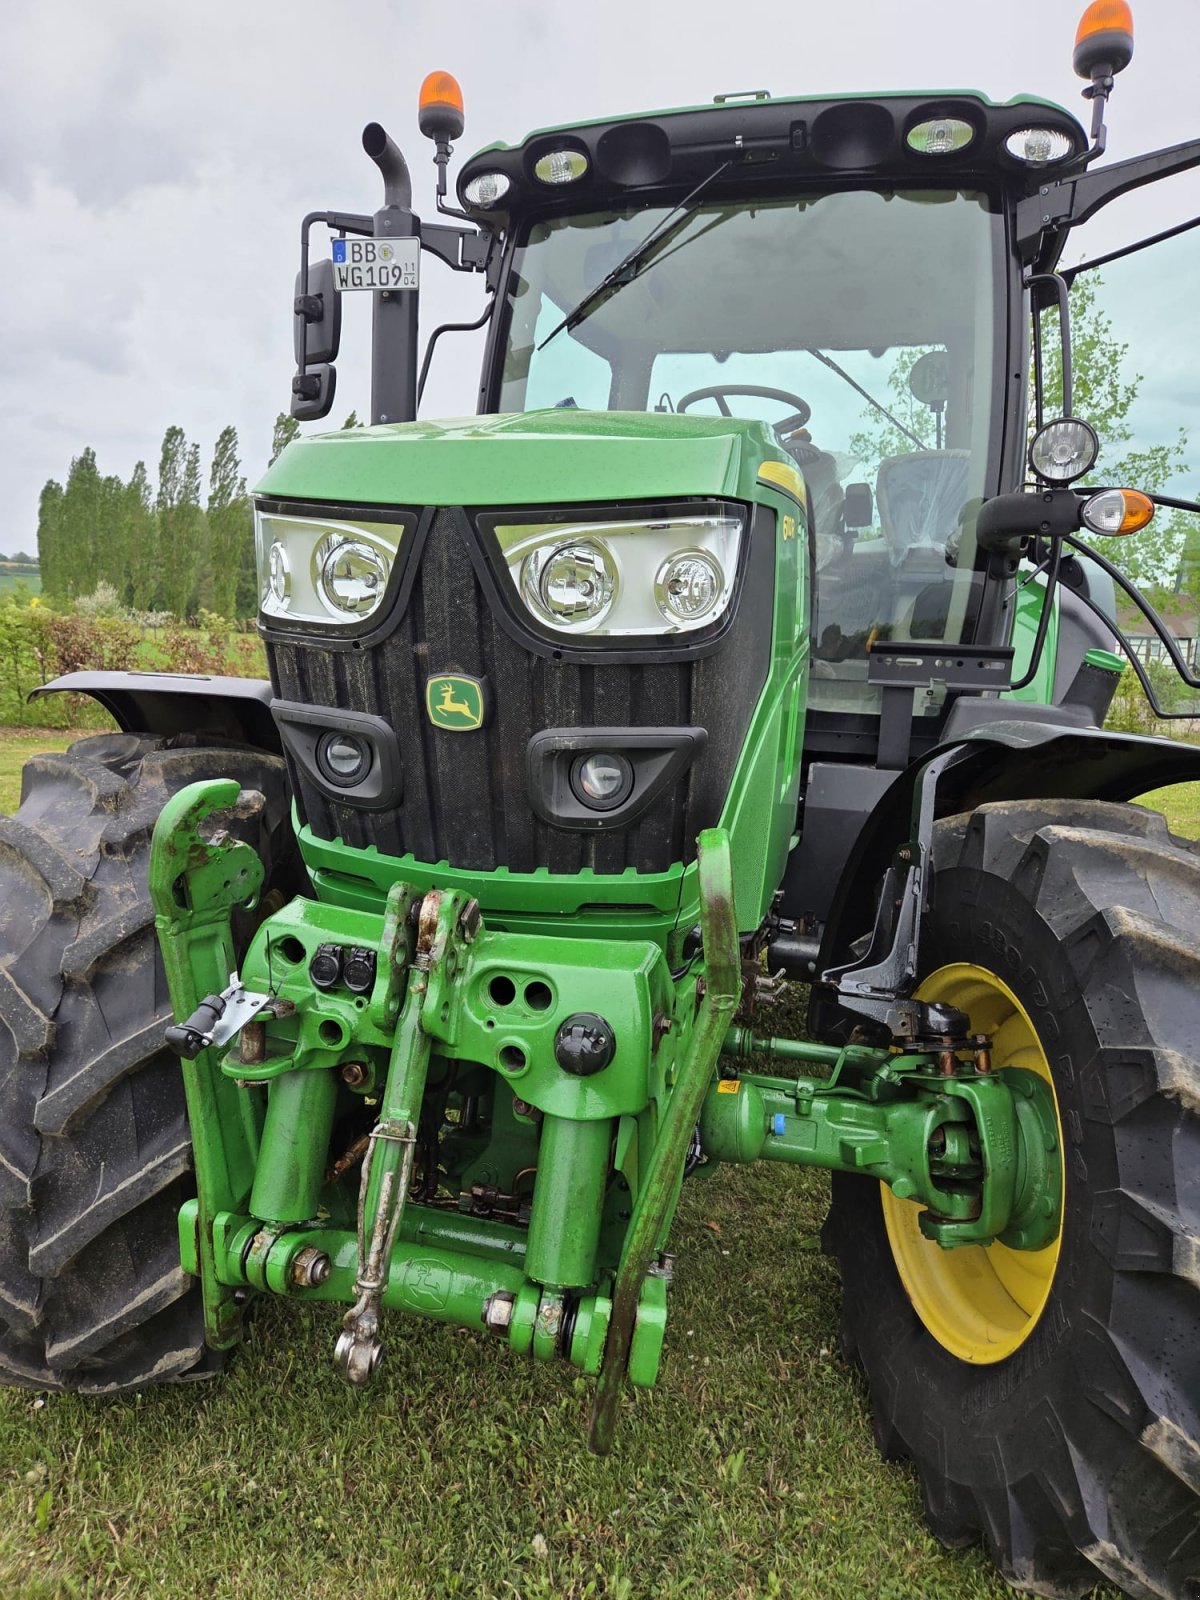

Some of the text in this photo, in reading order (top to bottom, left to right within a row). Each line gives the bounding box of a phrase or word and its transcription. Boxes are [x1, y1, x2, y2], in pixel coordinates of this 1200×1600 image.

[337, 254, 343, 262] D
[352, 243, 376, 263] BB
[404, 262, 415, 272] 11
[338, 265, 402, 287] WG109
[404, 276, 415, 285] 04
